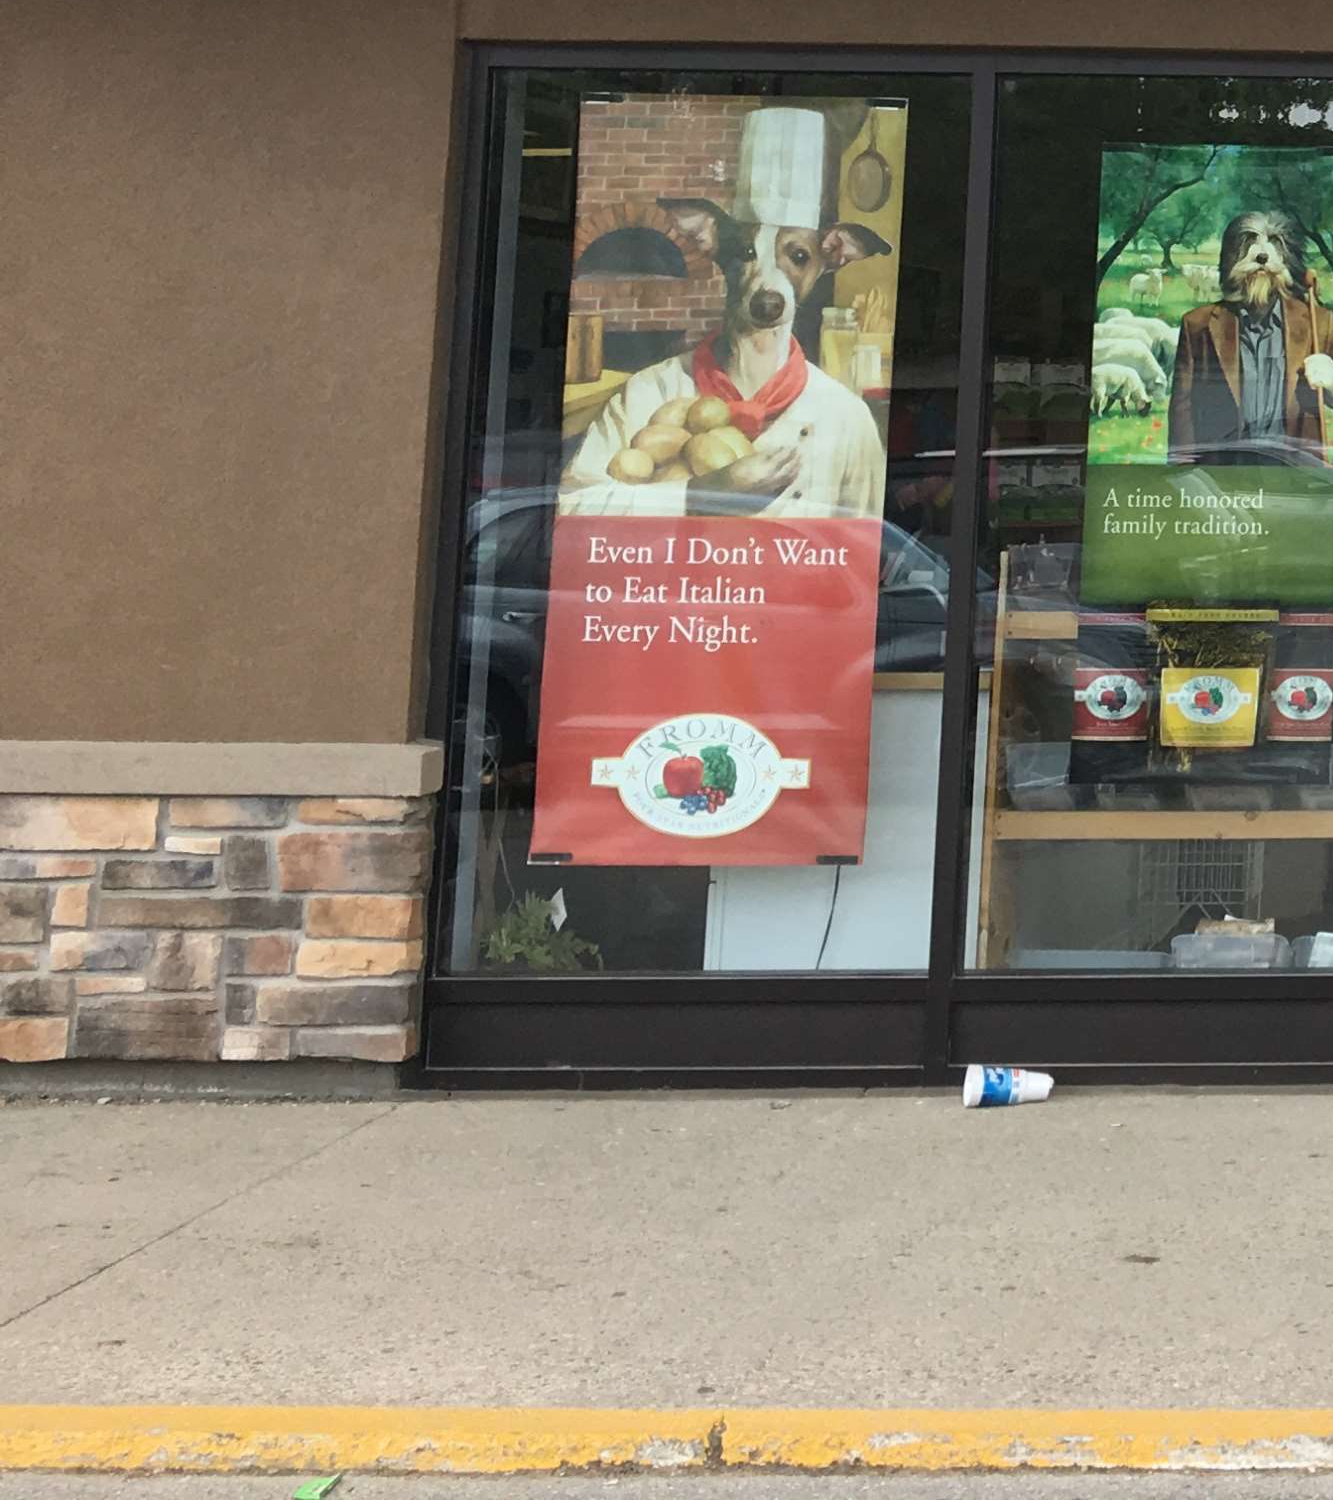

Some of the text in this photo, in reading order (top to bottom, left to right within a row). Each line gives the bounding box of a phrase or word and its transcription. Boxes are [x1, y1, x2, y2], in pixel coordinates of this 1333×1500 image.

[1102, 487, 1264, 508] A time honored
[1103, 512, 1270, 540] family tradition.
[586, 536, 849, 567] Even I Don't Want
[585, 576, 767, 605] to Eat Italian
[581, 615, 759, 653] Every Night.
[637, 719, 767, 759] FROMM
